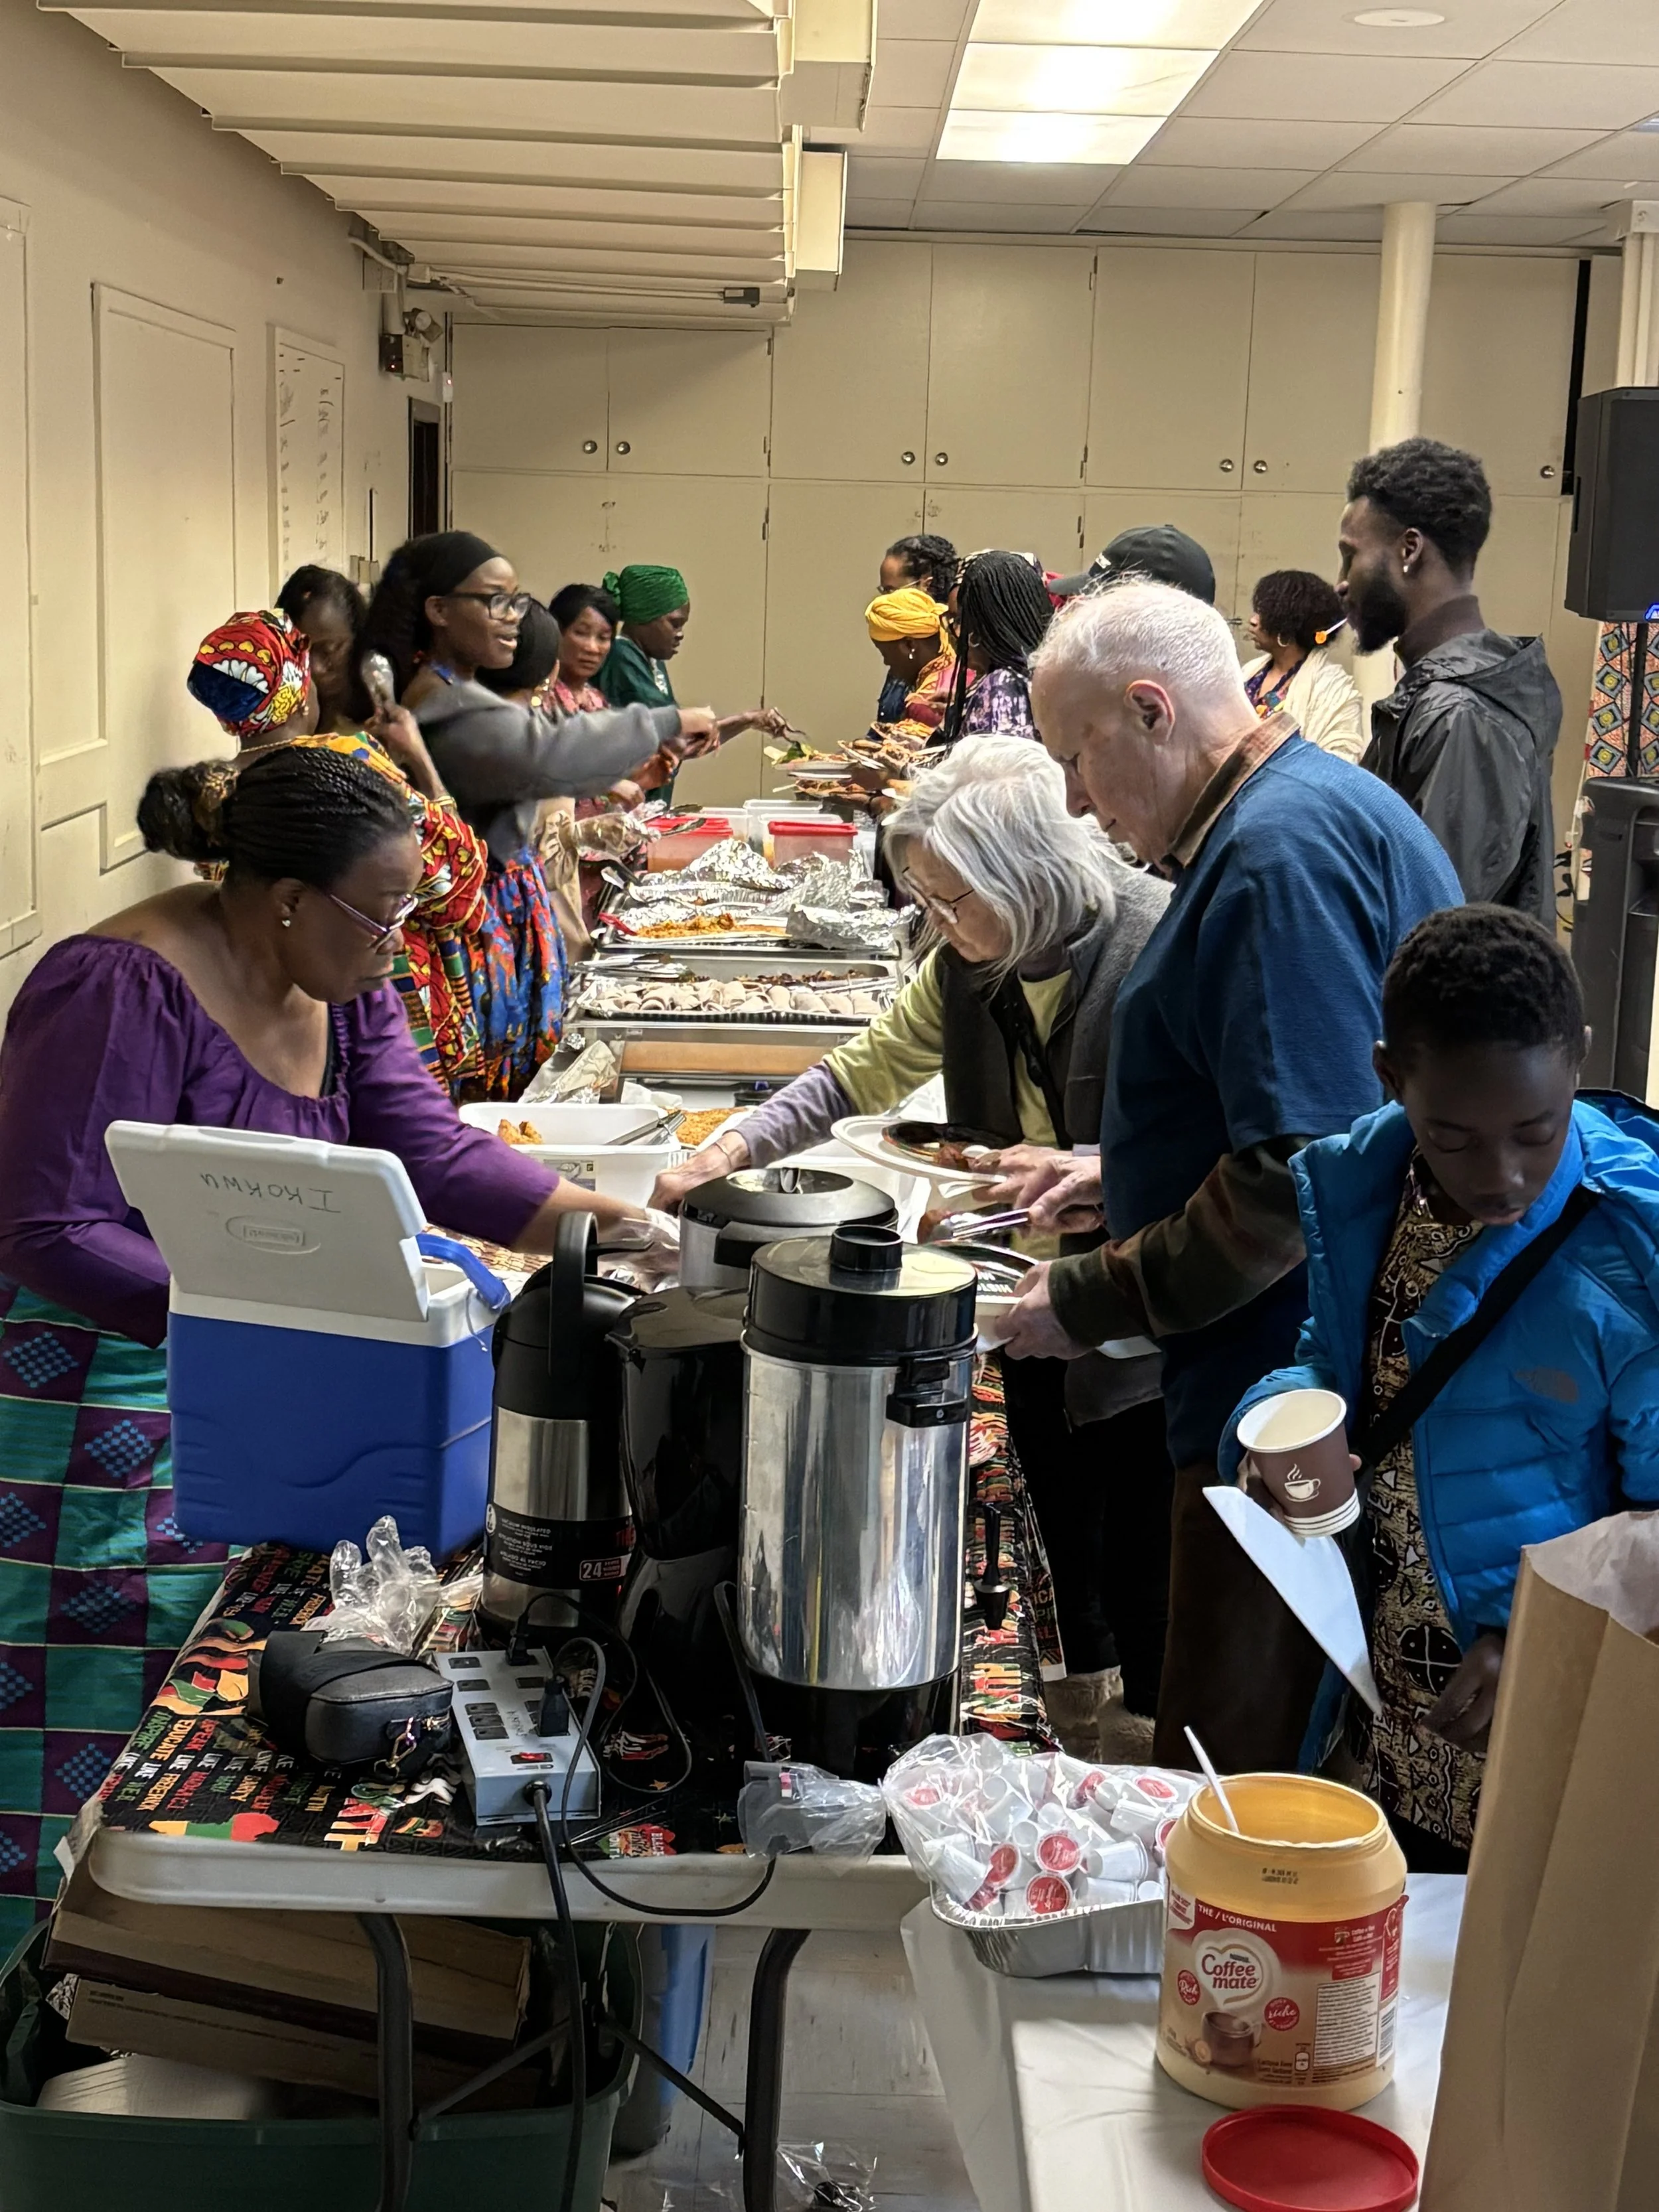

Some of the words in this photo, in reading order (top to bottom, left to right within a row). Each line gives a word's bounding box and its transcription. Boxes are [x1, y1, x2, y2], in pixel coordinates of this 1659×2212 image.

[582, 1562, 602, 1579] 24
[149, 1718, 198, 1761] EDUCATE
[1198, 1903, 1214, 1917] THE
[1221, 1911, 1277, 1933] L'ORIGINAL
[1201, 1953, 1256, 1977] Coffee
[1212, 1976, 1258, 1990] mate
